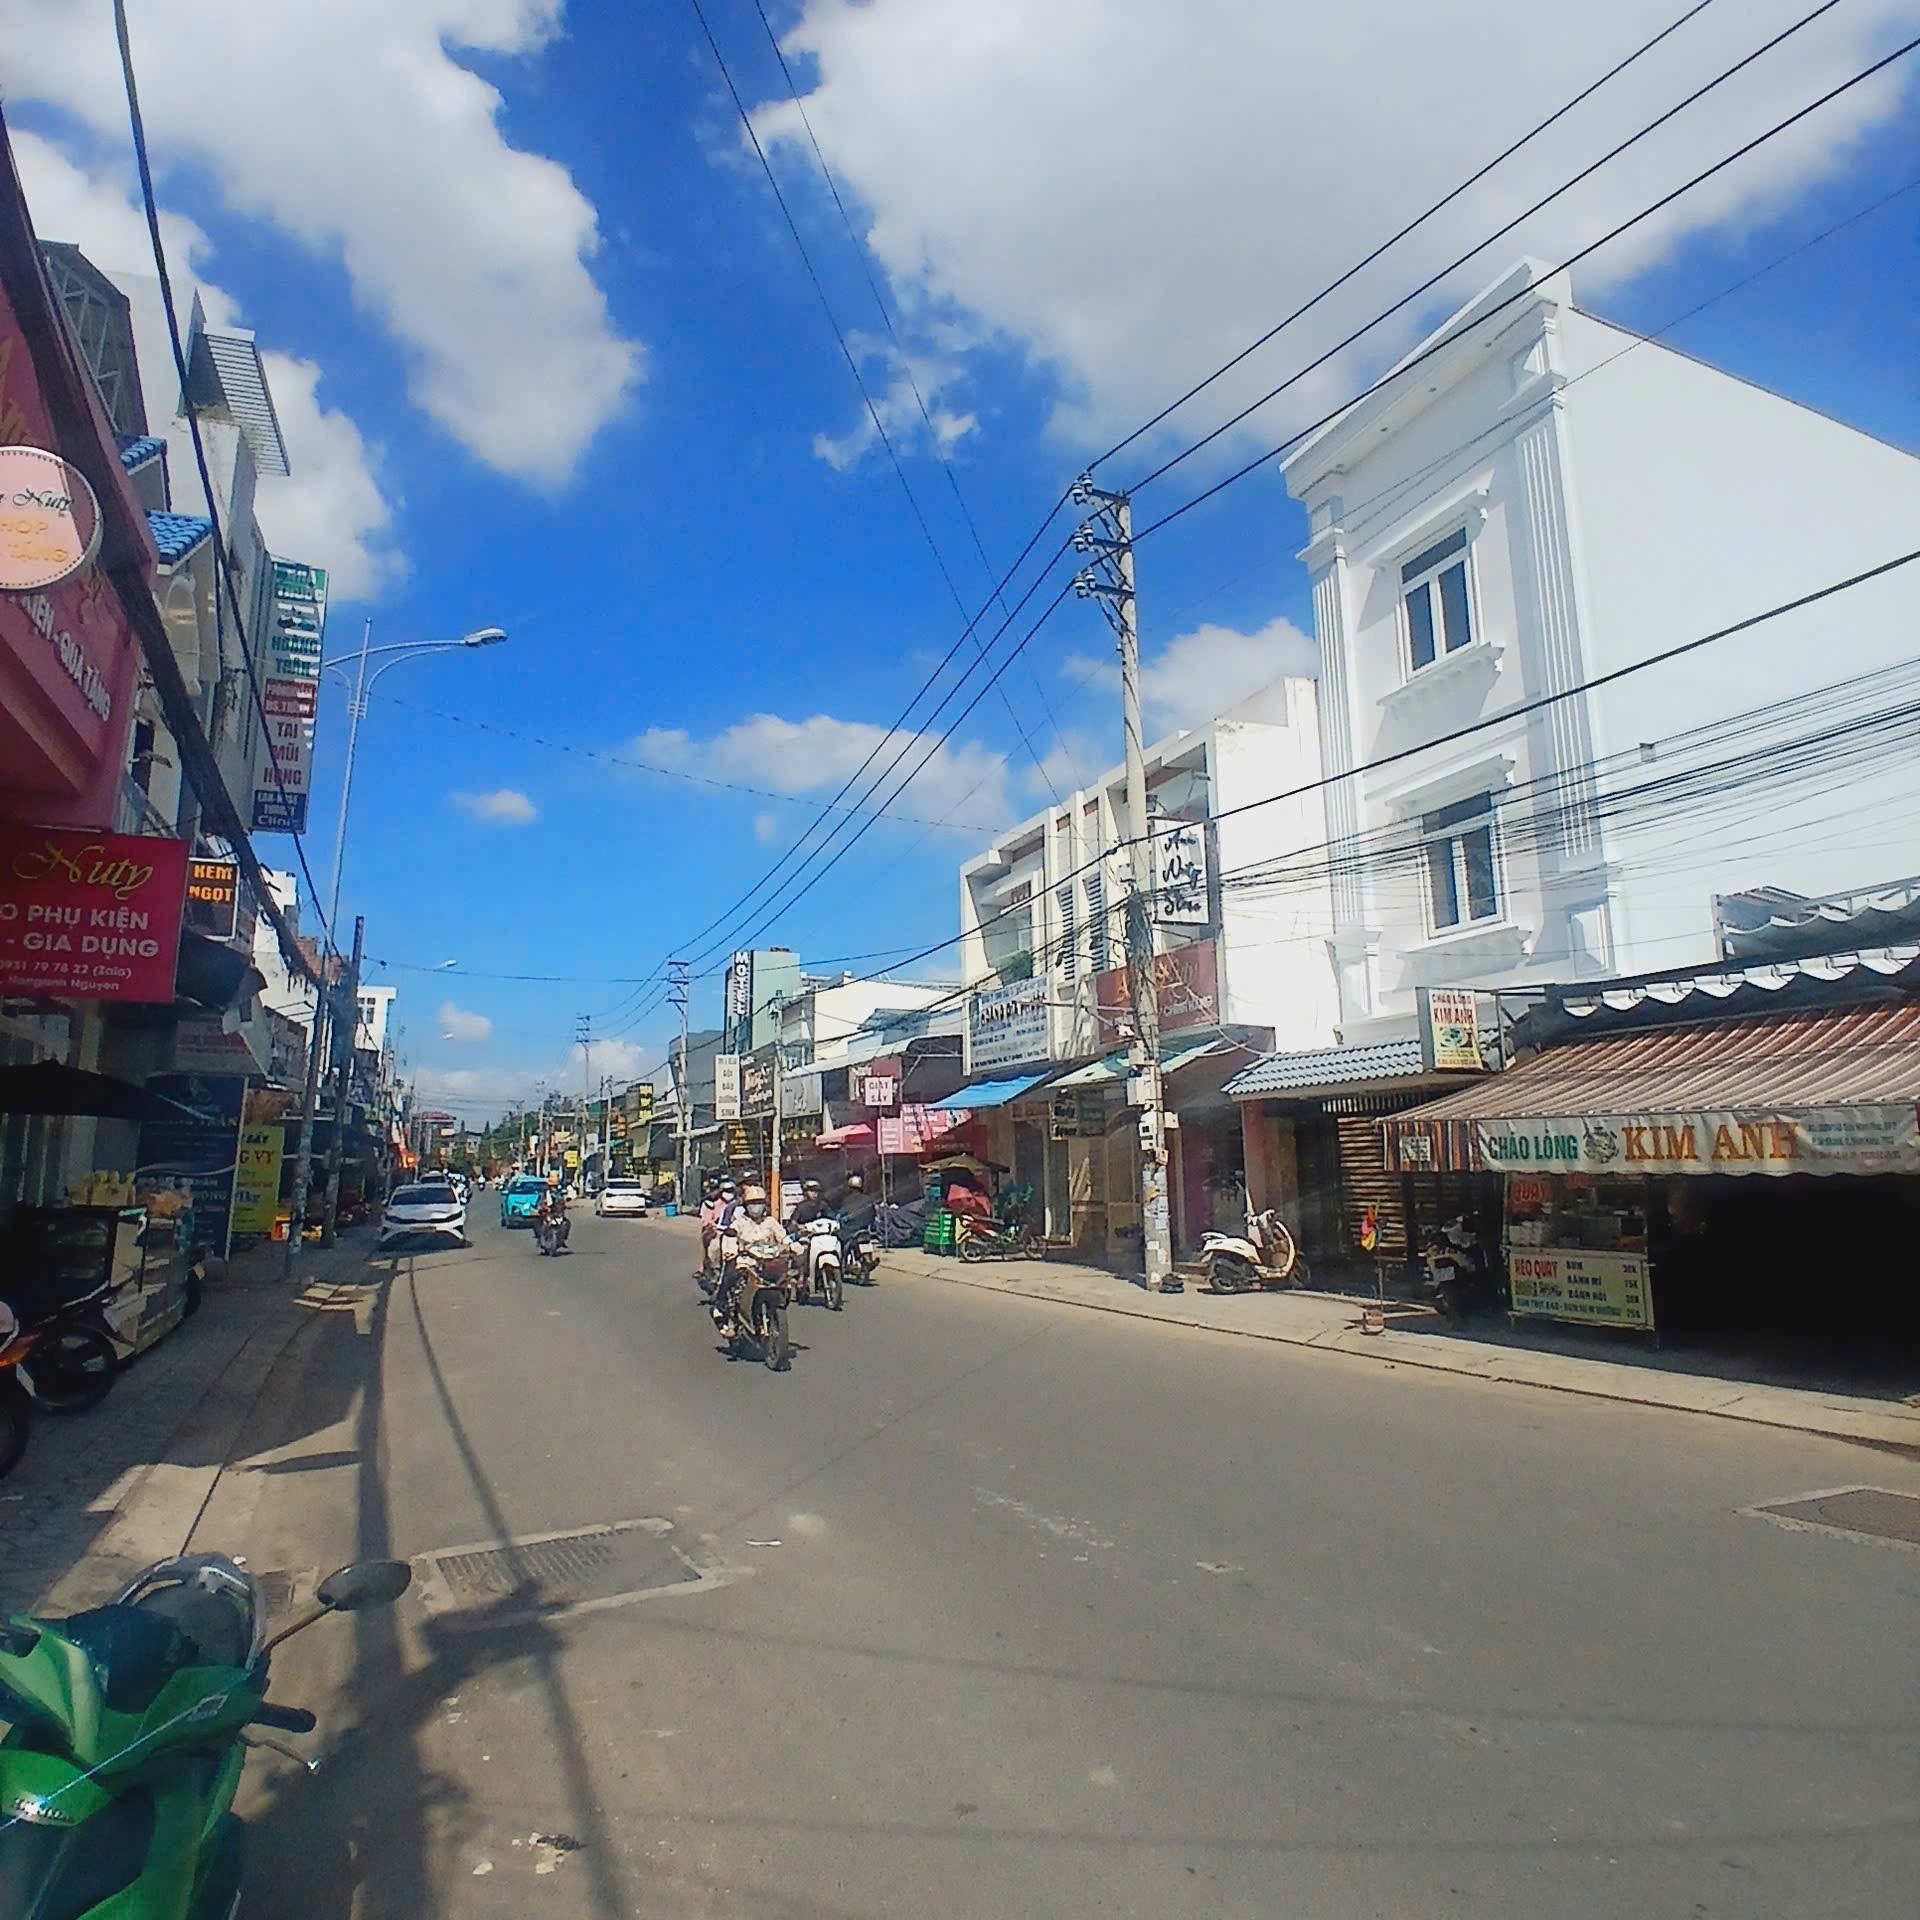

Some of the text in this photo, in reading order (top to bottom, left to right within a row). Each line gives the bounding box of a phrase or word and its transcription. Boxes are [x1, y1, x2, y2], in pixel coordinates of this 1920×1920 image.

[277, 721, 299, 739] TAI
[12, 842, 154, 900] Nuty
[193, 864, 233, 880] KEM
[188, 885, 234, 904] NGỌT
[27, 904, 82, 930] PHỤ
[90, 906, 149, 934] KIỆN
[23, 932, 160, 960] GIA DỤNG
[735, 951, 750, 1016] MOTEL
[1433, 1007, 1474, 1025] KIM ANH
[1622, 1124, 1699, 1161] KIM
[1711, 1121, 1804, 1161] ANH
[1533, 1260, 1558, 1280] QUAY
